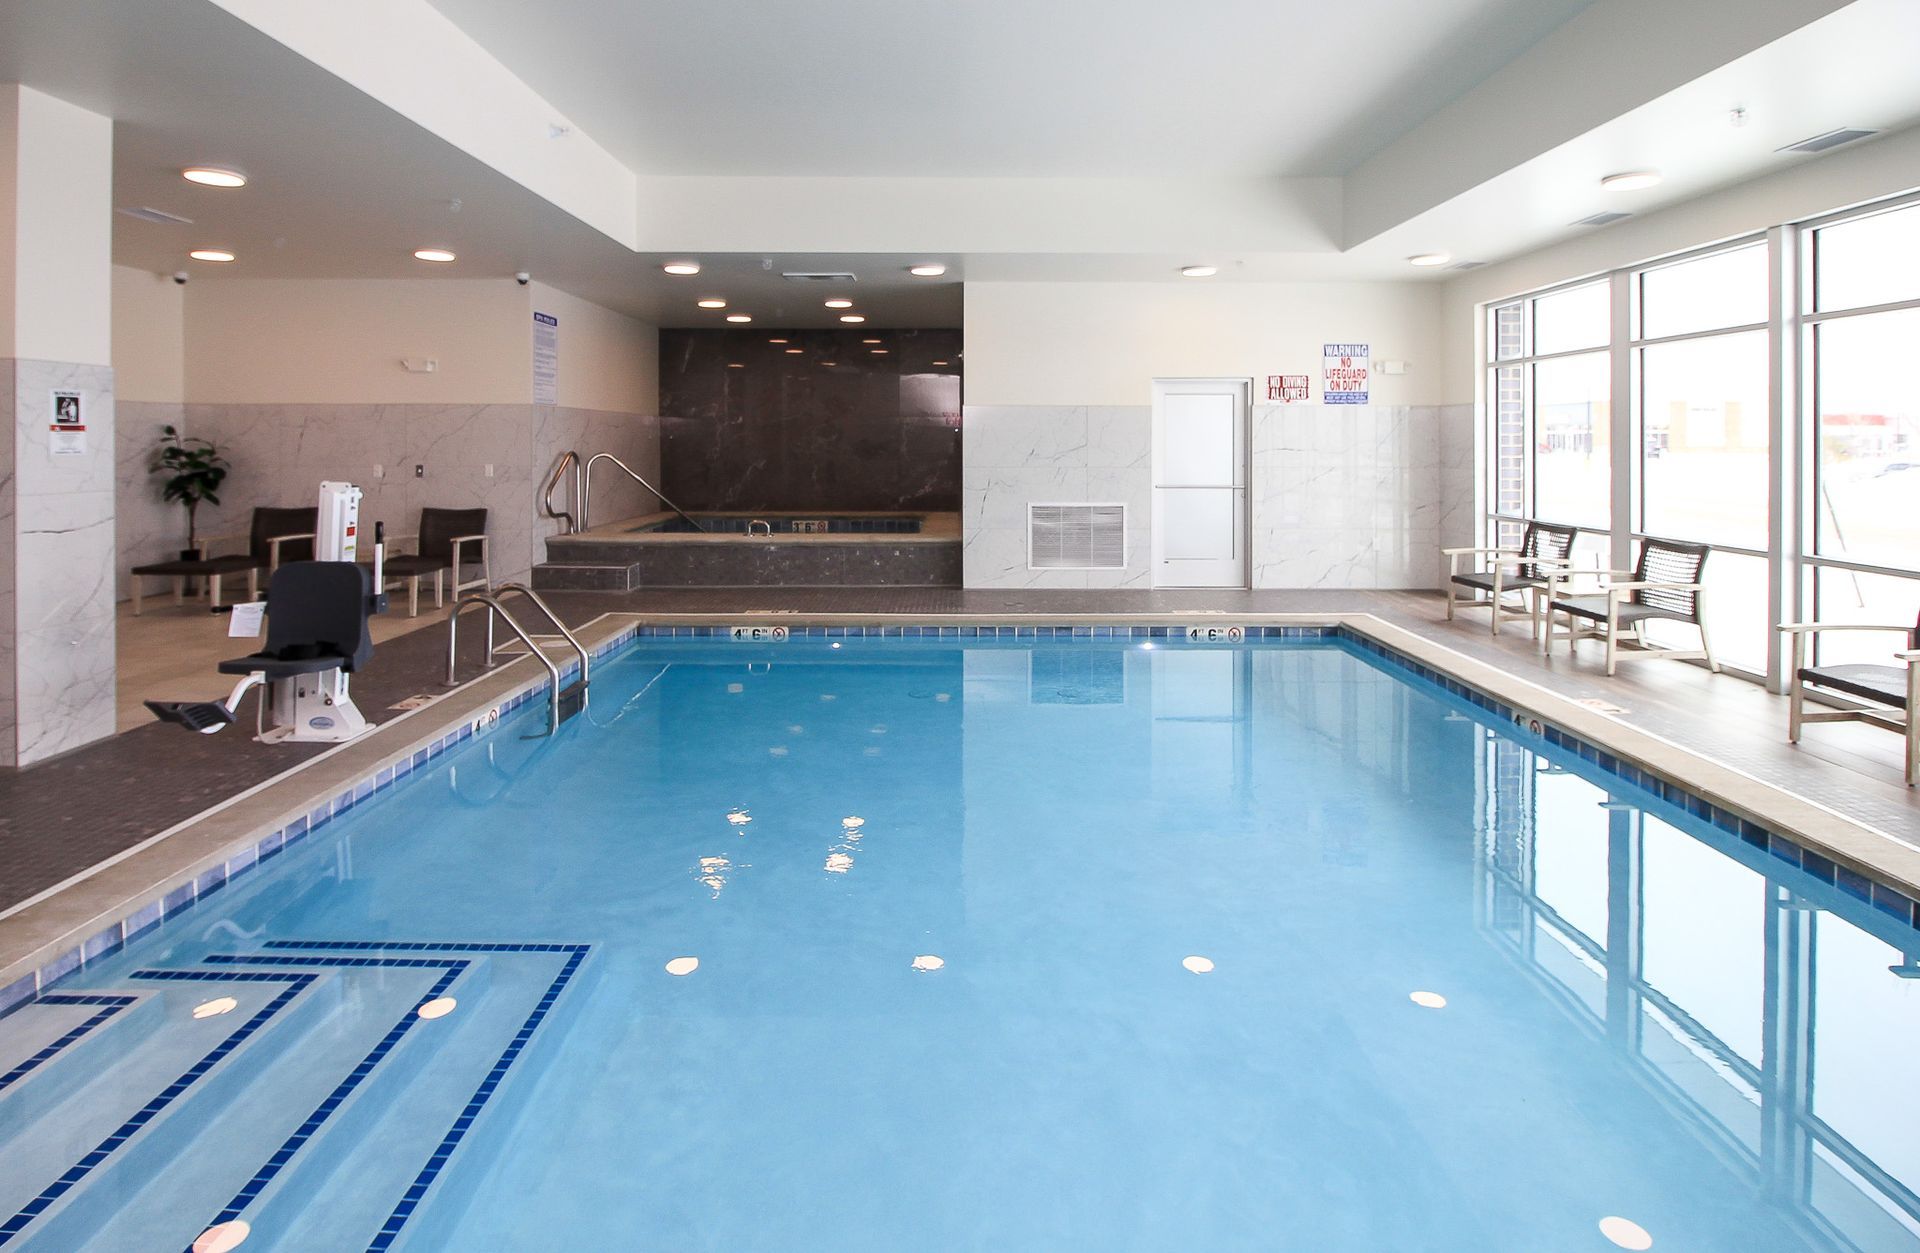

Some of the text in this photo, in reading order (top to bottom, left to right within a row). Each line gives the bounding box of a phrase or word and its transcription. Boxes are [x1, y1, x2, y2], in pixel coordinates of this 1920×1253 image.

[1325, 345, 1367, 357] WARNING
[1341, 358, 1351, 368] NO
[1325, 369, 1367, 379] LIFEGUARD
[1270, 376, 1307, 388] NO DIVING
[1330, 380, 1362, 391] ON DUTY
[1270, 388, 1307, 400] ALLOWED
[734, 629, 741, 639] 4
[1190, 629, 1198, 639] 4
[1208, 629, 1216, 640] 6
